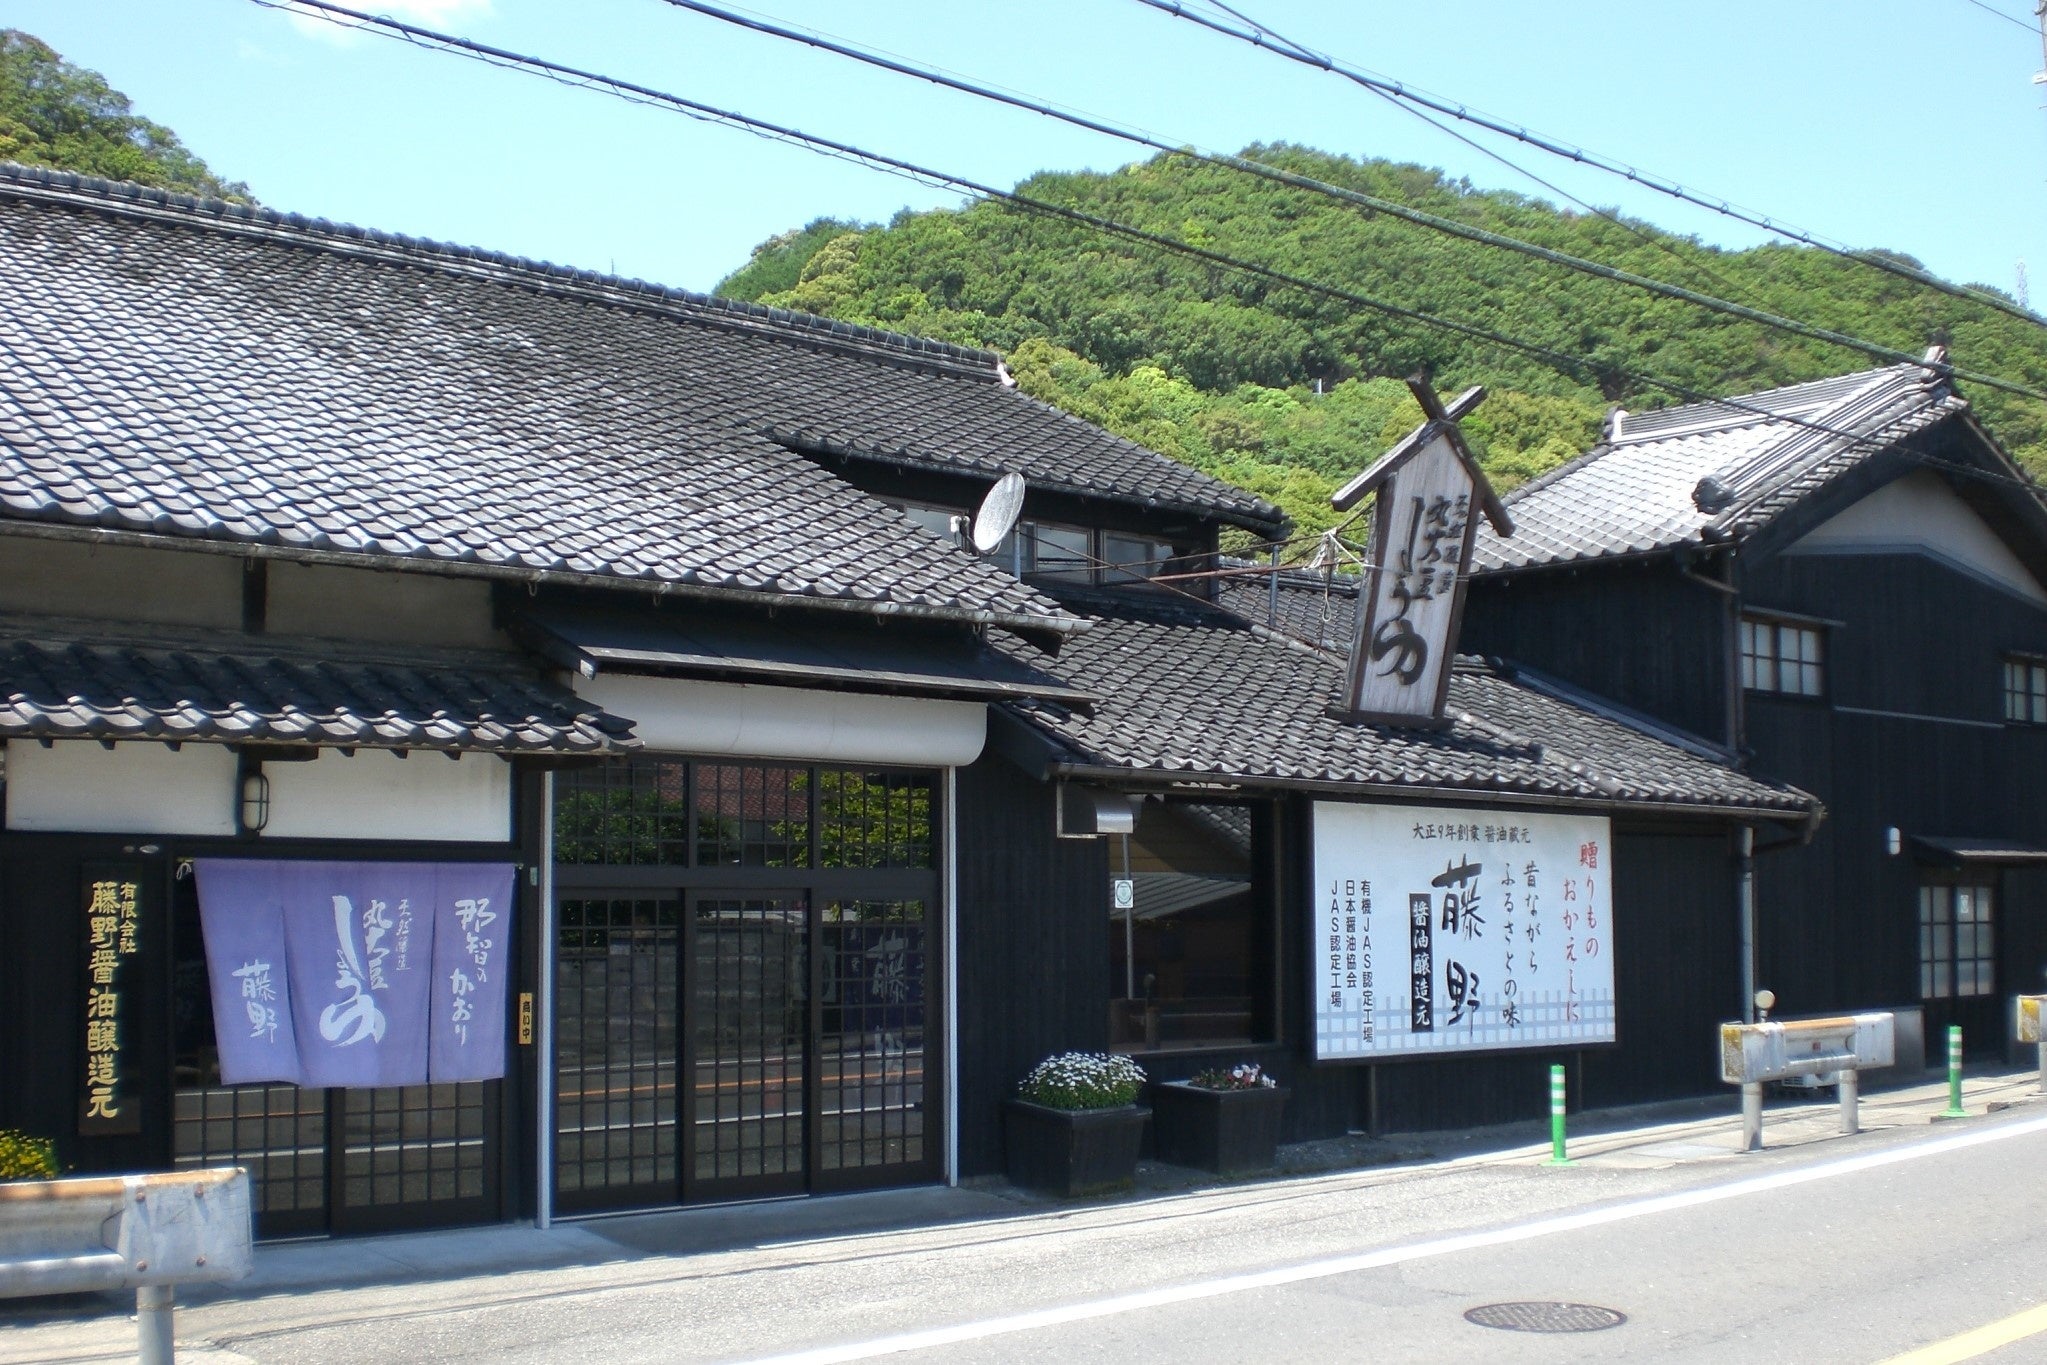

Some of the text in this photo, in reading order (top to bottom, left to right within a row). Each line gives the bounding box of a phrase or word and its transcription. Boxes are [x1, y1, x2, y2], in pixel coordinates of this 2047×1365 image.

[1413, 822, 1480, 842] 大正9年創業
[119, 881, 137, 954] 有限会社
[455, 898, 497, 983] 那智の
[1329, 880, 1342, 1007] JAS認定工場
[1345, 880, 1357, 988] 日本醤油協会
[1431, 853, 1486, 1037] 藤野
[1501, 863, 1521, 1029] ふるさとの味
[1523, 860, 1541, 974] 昔ながら
[1562, 879, 1579, 1023] おかえしに
[1579, 842, 1599, 957] 贈りもの
[87, 881, 120, 1119] 藤野醤油醸造元
[231, 959, 278, 1044] 藤野
[449, 968, 475, 1047] かおり
[1360, 879, 1373, 1043] 有機JAS認定工場
[1412, 900, 1432, 1026] 醤油醸造元
